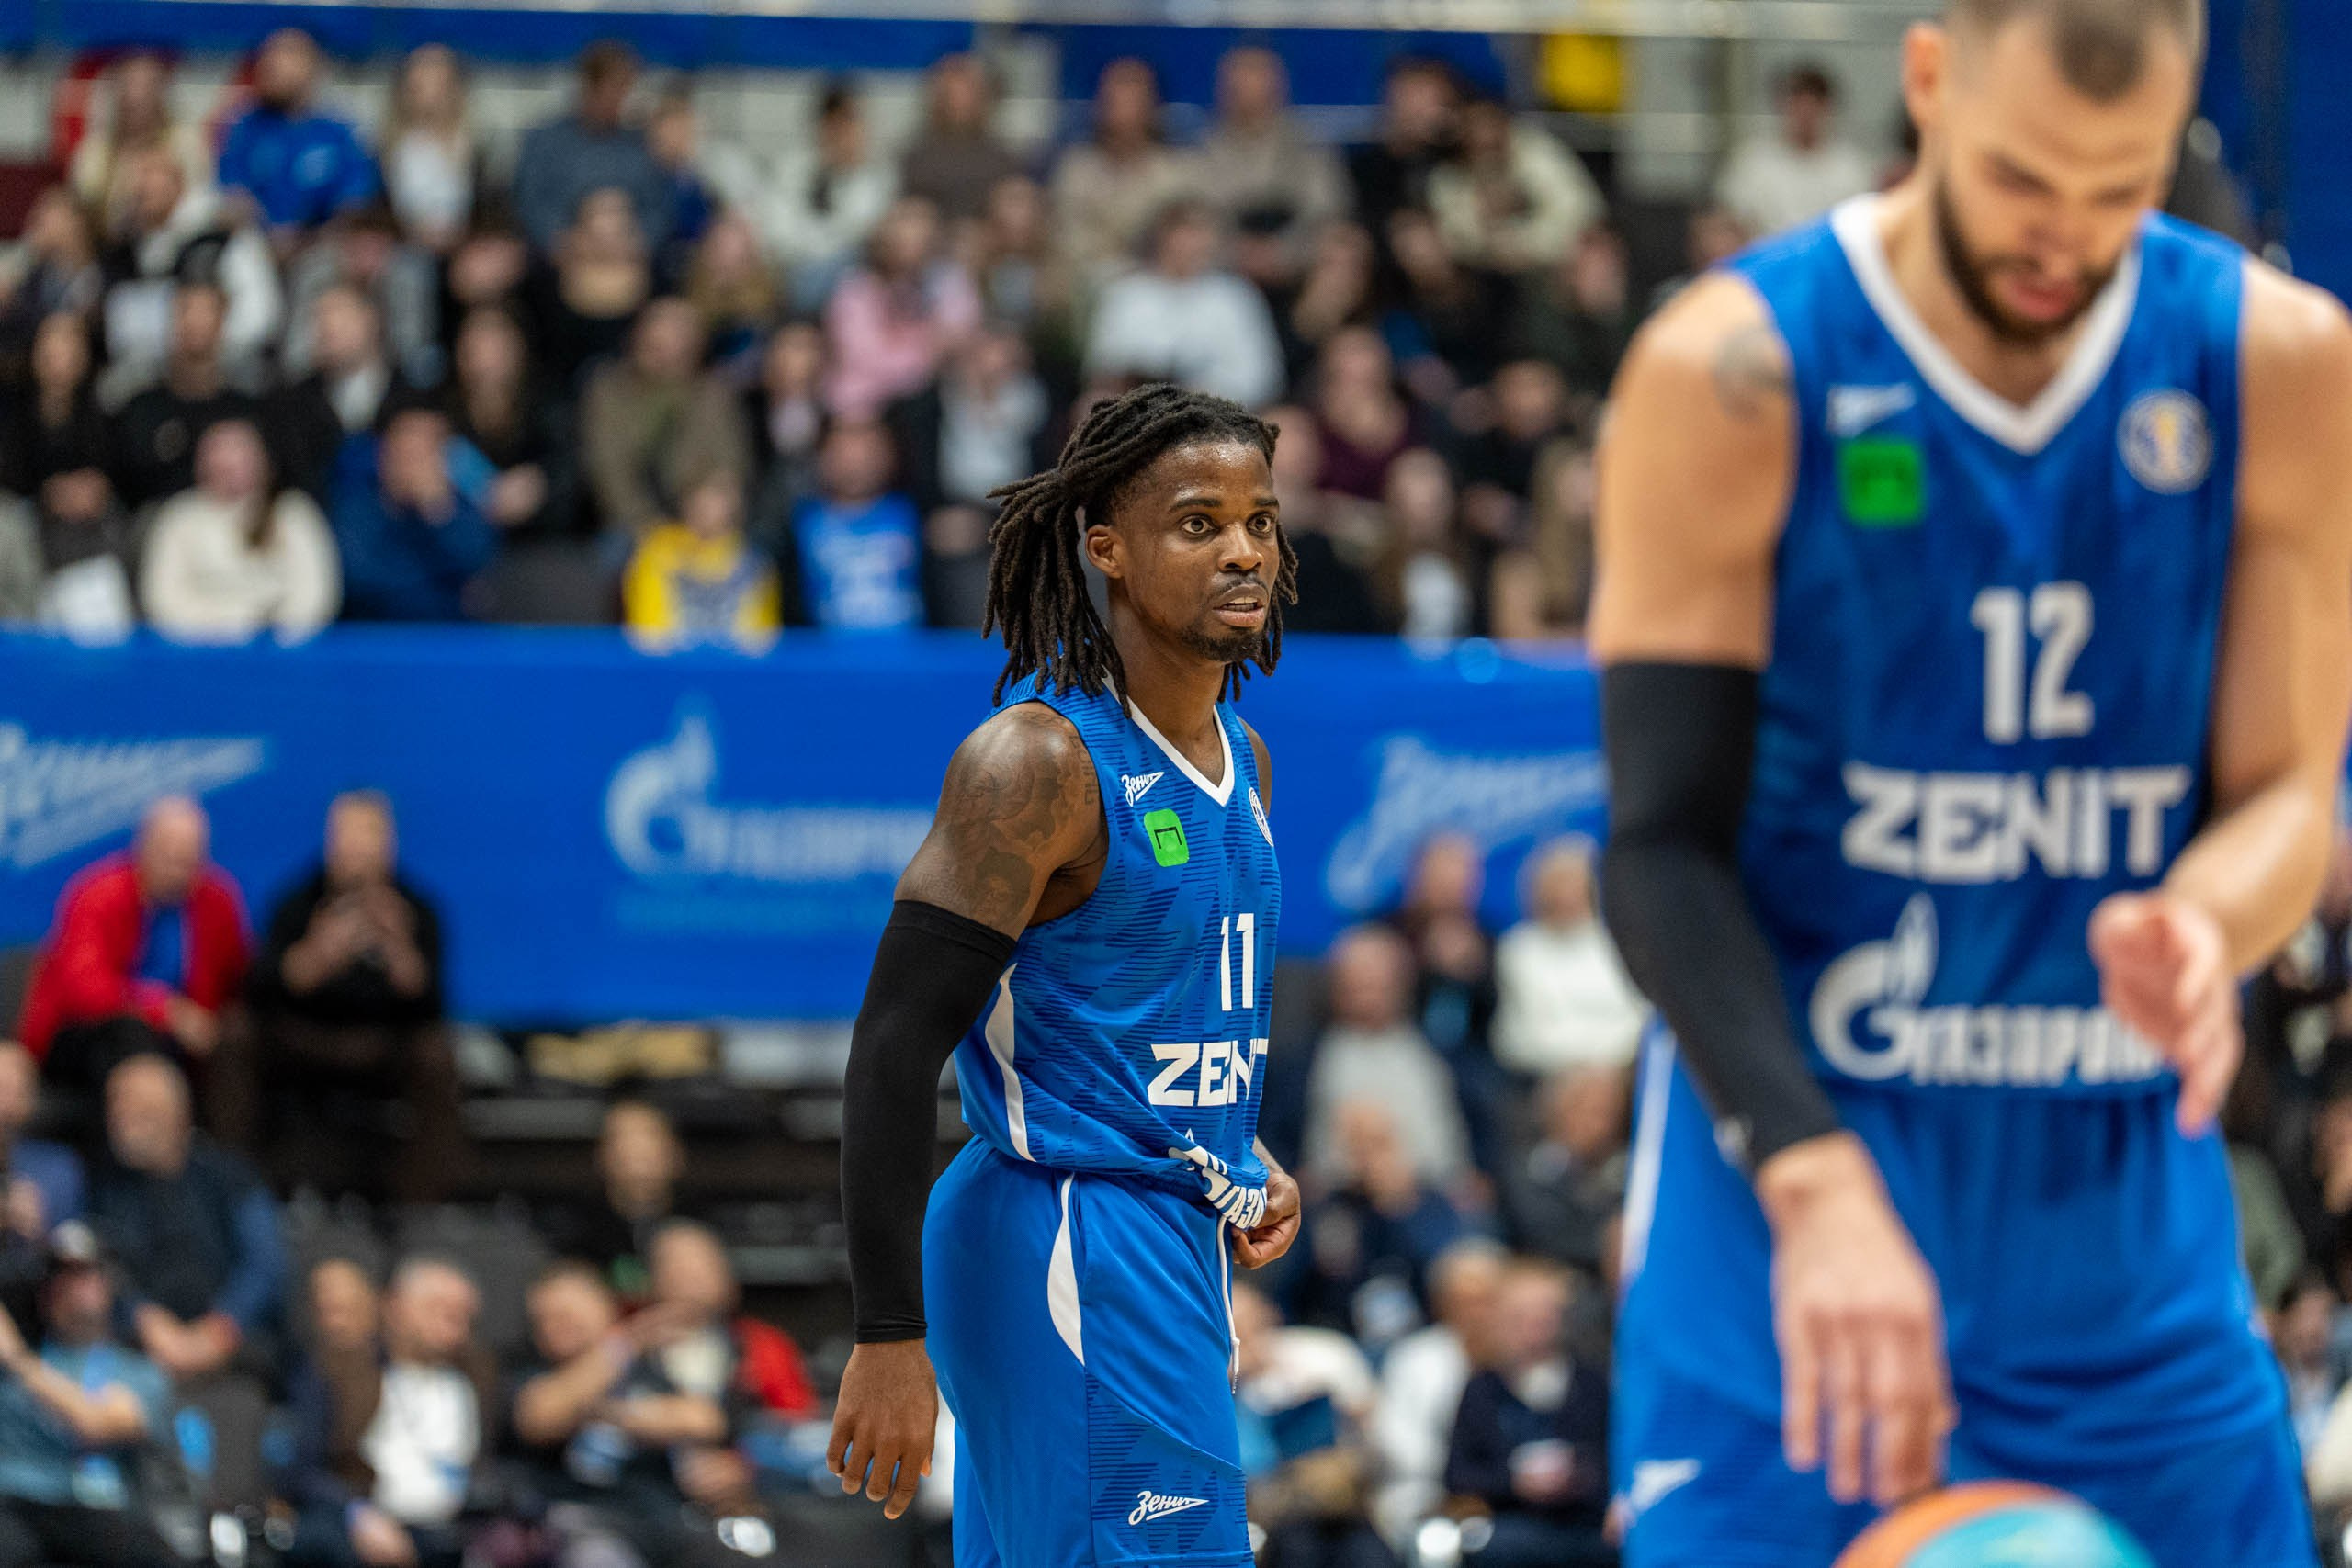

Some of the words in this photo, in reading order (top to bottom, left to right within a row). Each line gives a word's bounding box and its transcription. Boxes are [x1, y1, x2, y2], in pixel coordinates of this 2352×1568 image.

[1970, 581, 2095, 744] 12
[1841, 761, 2191, 884] ZENIT
[1220, 912, 1255, 1011] 11
[1147, 1038, 1269, 1107] ZEN
